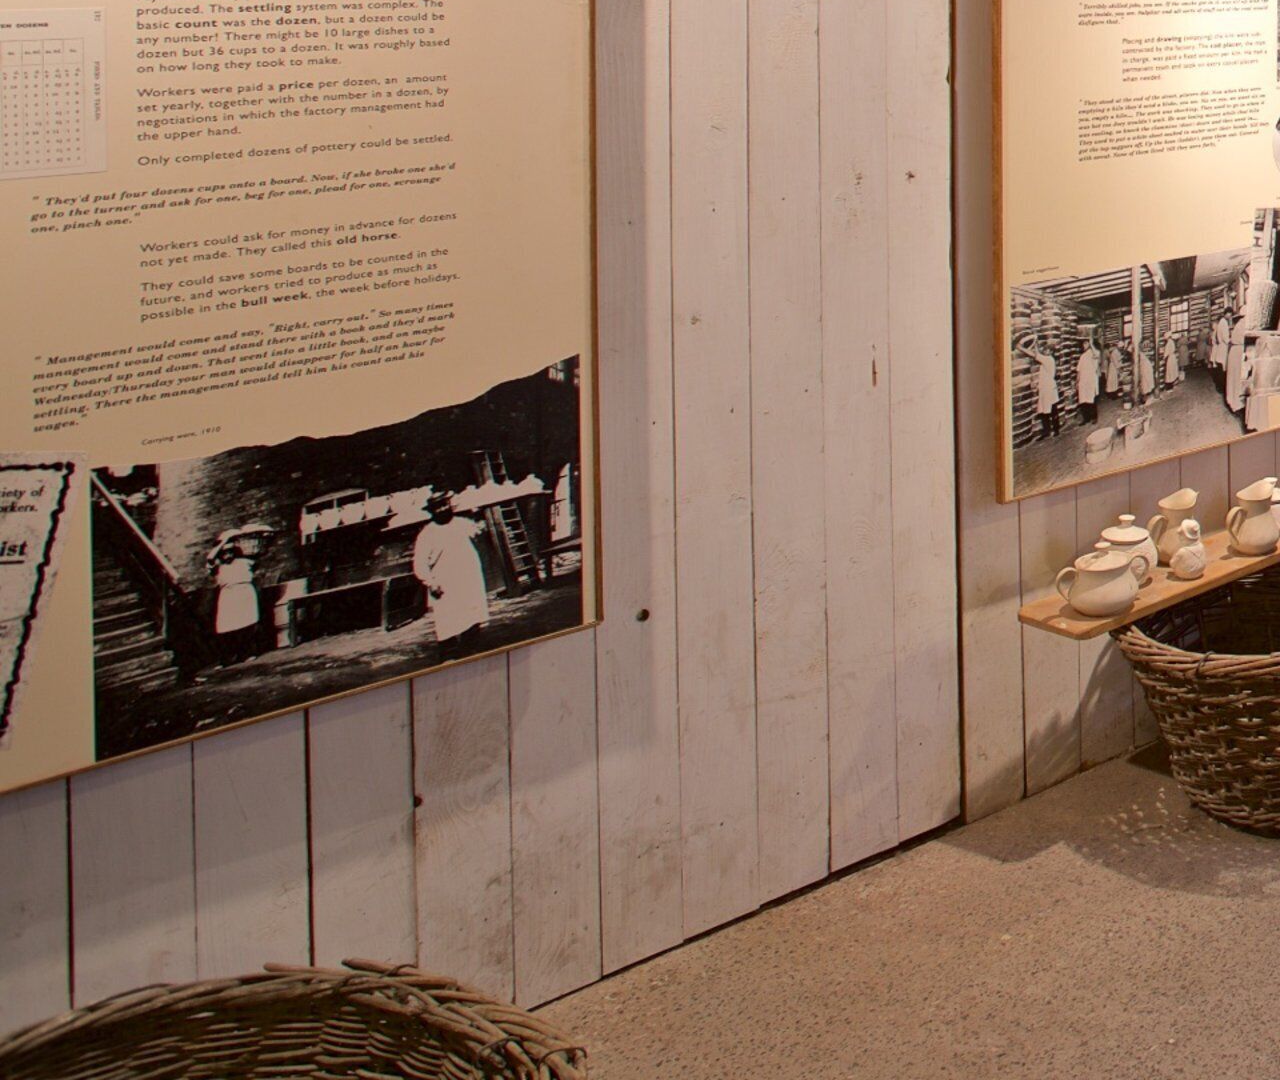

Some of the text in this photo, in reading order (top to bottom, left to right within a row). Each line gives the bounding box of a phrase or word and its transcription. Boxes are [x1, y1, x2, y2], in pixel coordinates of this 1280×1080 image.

[209, 4, 233, 13] The
[238, 3, 291, 14] settling
[296, 4, 337, 13] system
[423, 0, 443, 7] The
[137, 21, 169, 30] basic
[175, 20, 218, 28] count
[251, 18, 270, 26] the
[325, 16, 344, 24] but
[359, 14, 393, 23] dozen
[397, 13, 427, 22] could
[137, 50, 177, 59] dozen
[182, 48, 204, 57] but
[210, 47, 224, 55] 36
[229, 48, 257, 56] cups
[335, 42, 343, 50] It
[374, 40, 415, 50] roughly
[420, 38, 450, 47] based
[138, 156, 170, 166] Only
[175, 150, 243, 163] completed
[248, 148, 290, 156] dozens
[295, 144, 308, 153] of
[312, 143, 356, 154] pottery
[360, 138, 391, 148] could
[396, 138, 408, 146] be
[140, 241, 198, 252] Workers
[204, 234, 238, 246] could
[243, 232, 263, 242] ask
[267, 230, 286, 239] for
[290, 227, 330, 236] money
[349, 220, 394, 230] advance
[419, 214, 456, 223] dozens
[140, 259, 163, 267] not
[168, 256, 188, 267] yet
[236, 247, 267, 256] They
[271, 241, 306, 252] called
[311, 239, 332, 248] this
[336, 235, 357, 245] old
[31, 484, 45, 497] of
